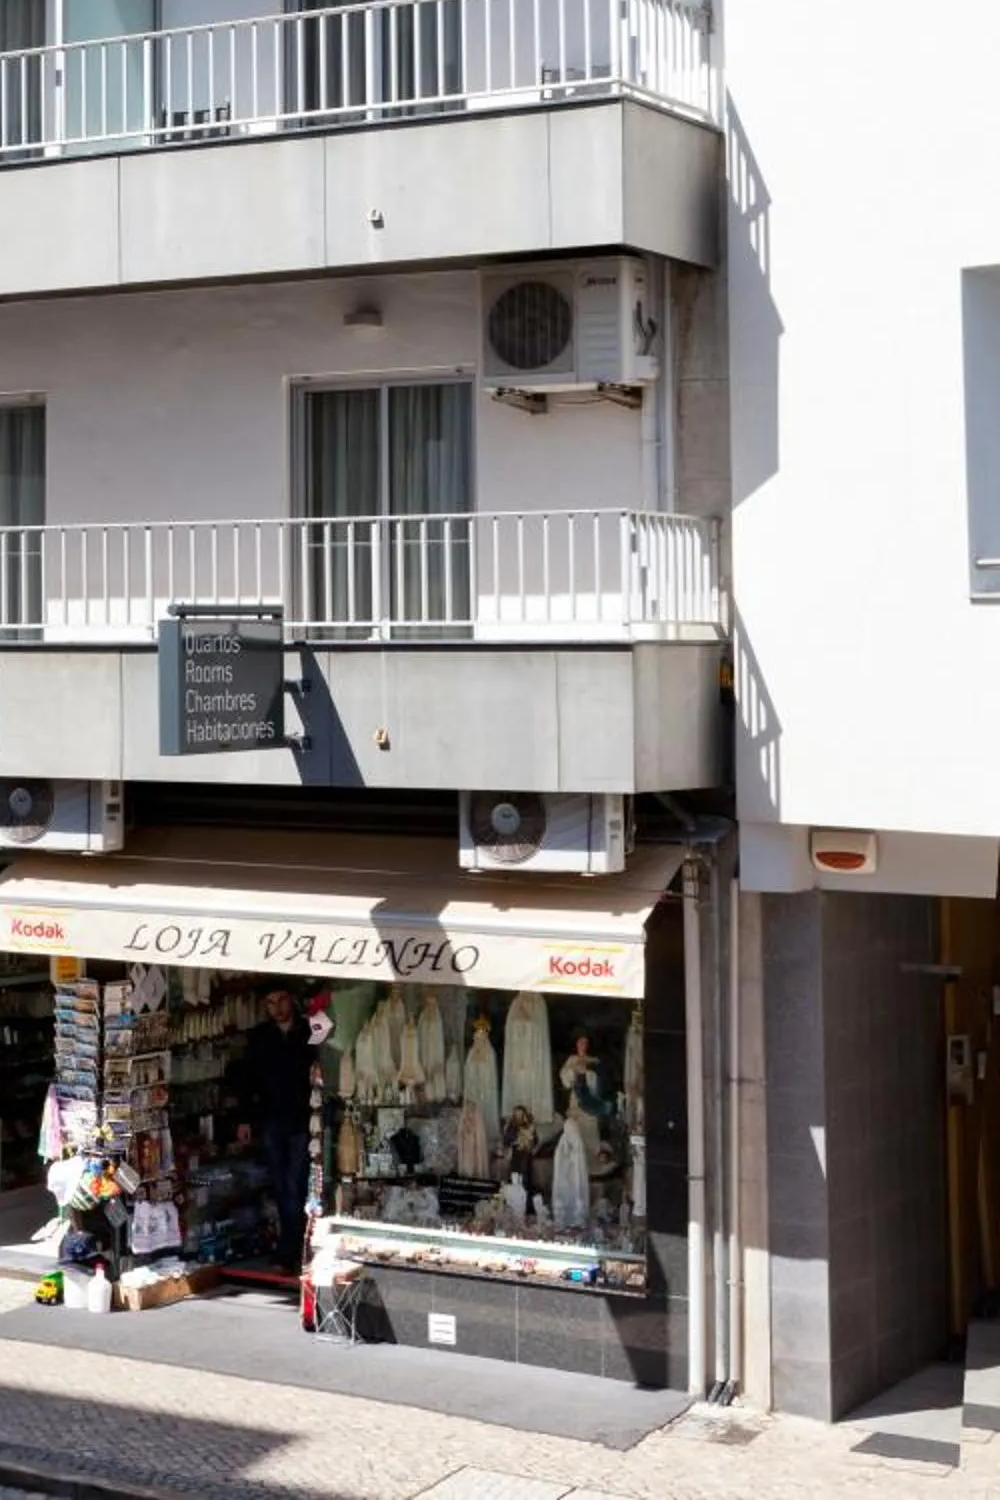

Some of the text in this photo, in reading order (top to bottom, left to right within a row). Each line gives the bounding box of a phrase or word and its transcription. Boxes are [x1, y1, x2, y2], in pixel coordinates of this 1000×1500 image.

[185, 632, 241, 655] Quartos
[185, 660, 234, 683] Rooms
[185, 689, 257, 713] Chambres
[186, 717, 276, 743] Habitaciones
[11, 918, 615, 977] Kodak LOJA VALINHO Kodak
